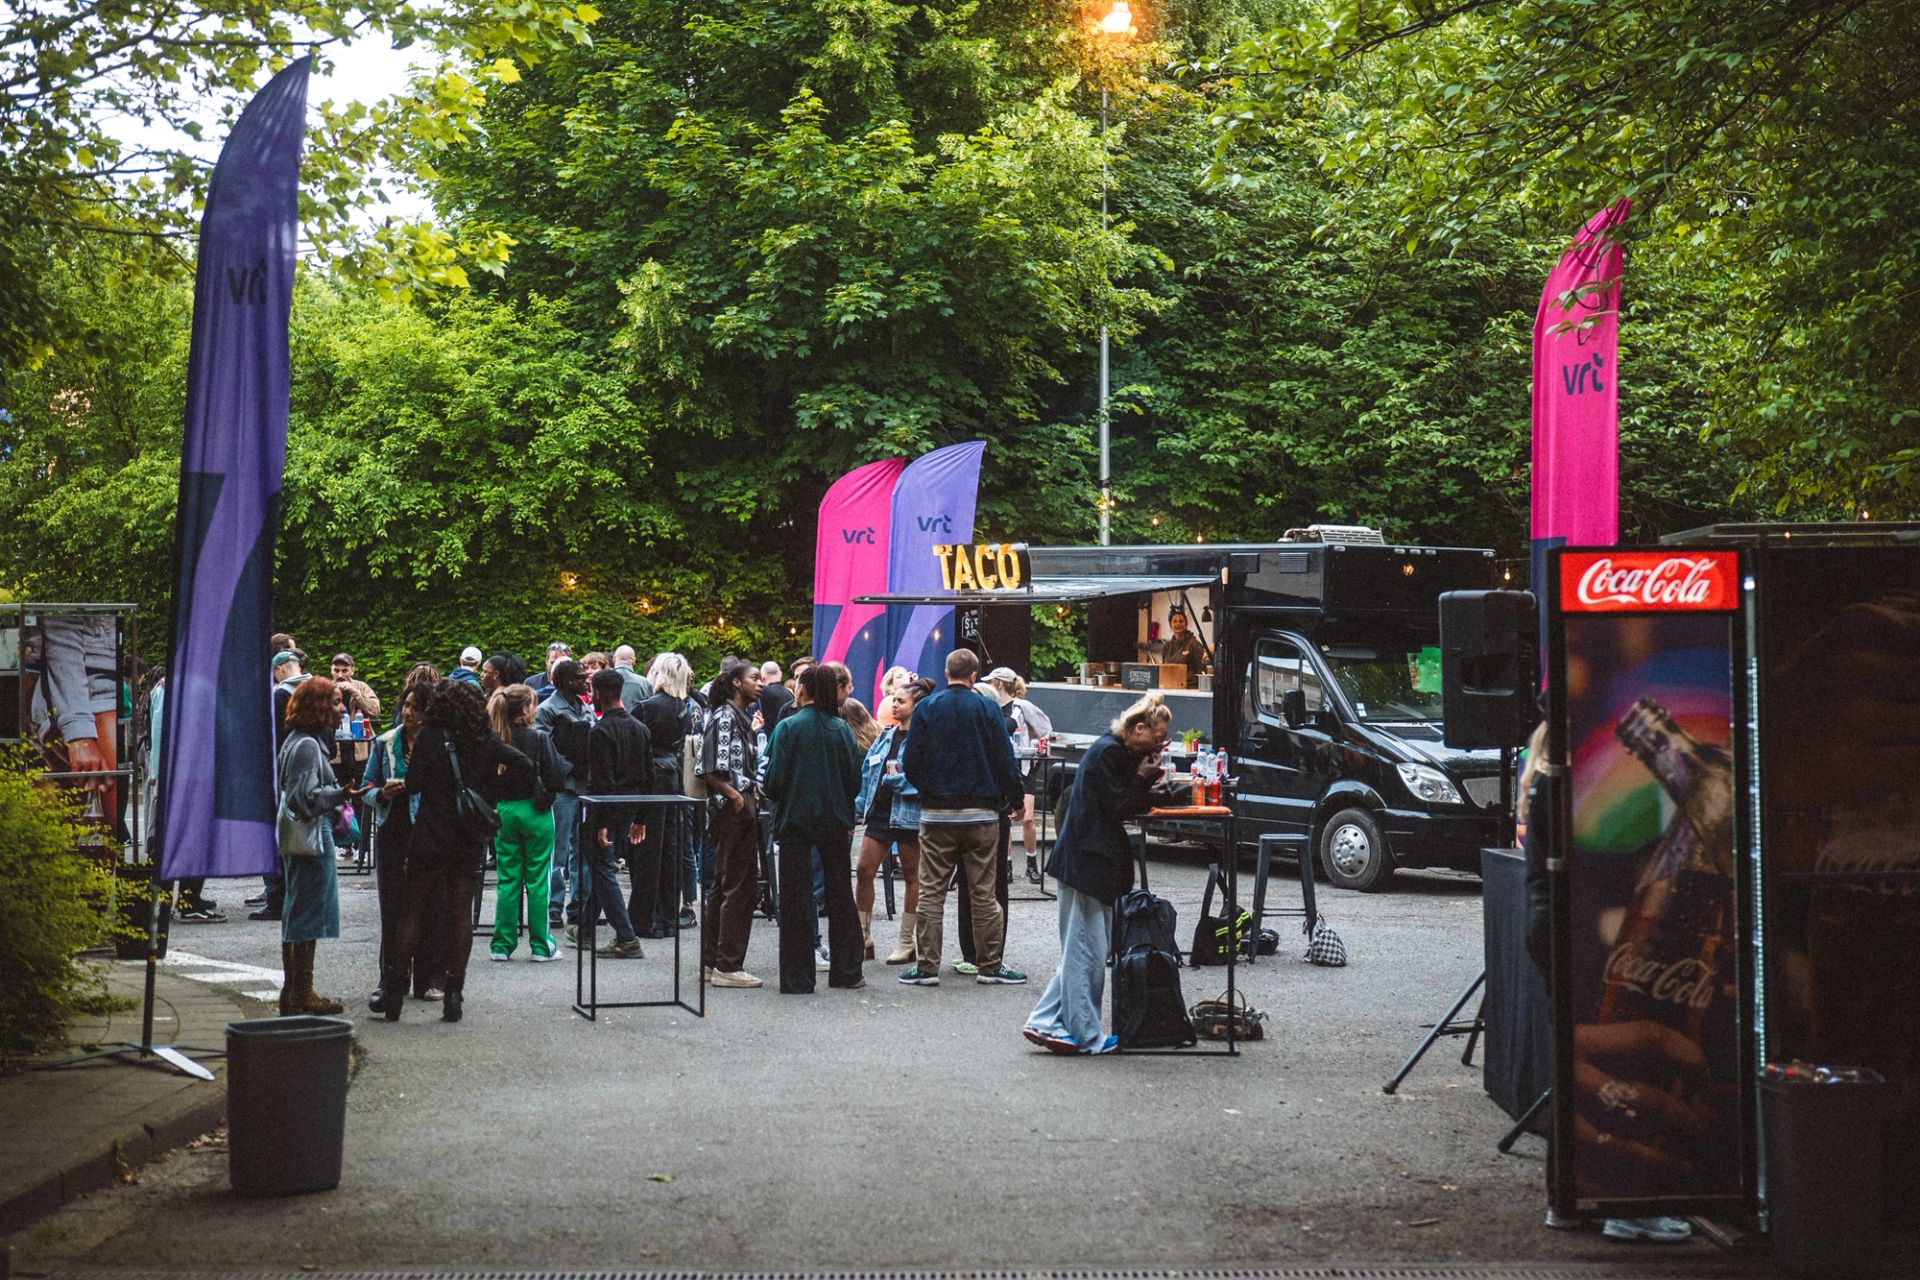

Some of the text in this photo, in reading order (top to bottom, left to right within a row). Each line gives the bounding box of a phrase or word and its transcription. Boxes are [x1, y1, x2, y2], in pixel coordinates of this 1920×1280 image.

[1563, 353, 1604, 395] vrt
[842, 527, 876, 545] vrt
[917, 514, 952, 534] vrt
[932, 543, 1021, 591] TACO
[1577, 558, 1718, 604] Coca-Cola
